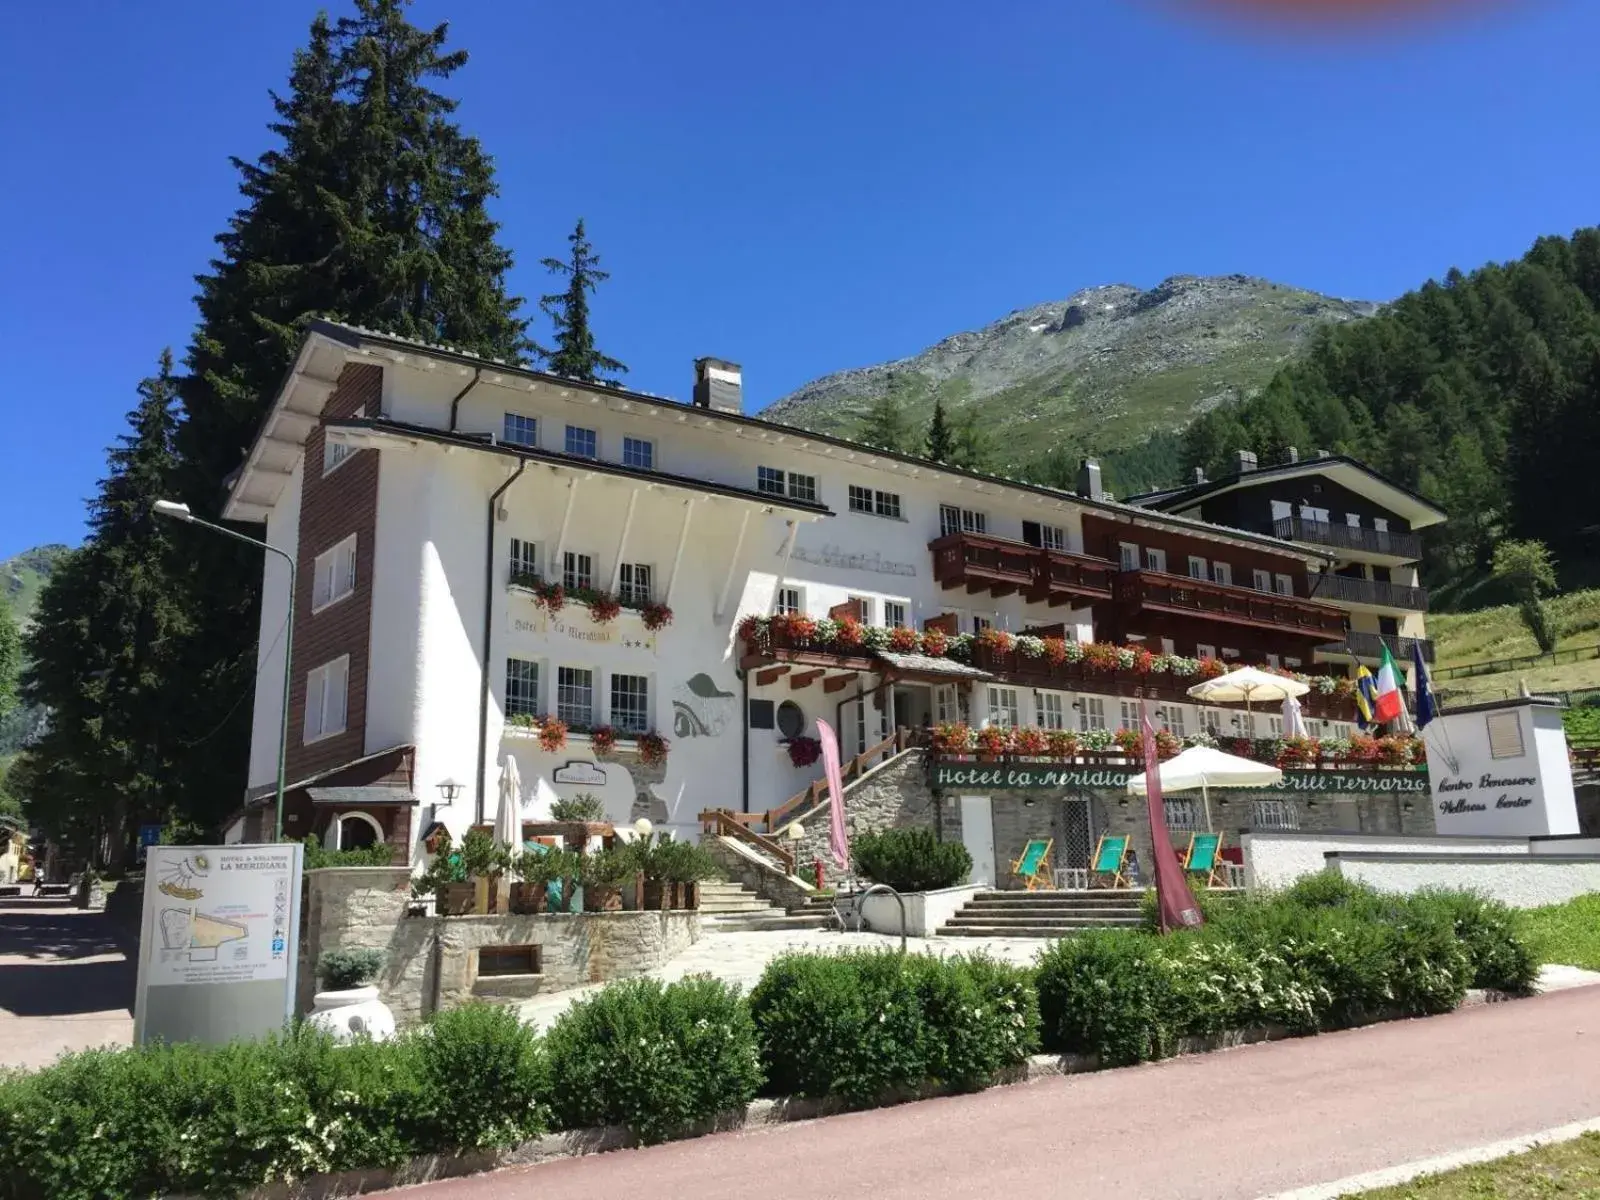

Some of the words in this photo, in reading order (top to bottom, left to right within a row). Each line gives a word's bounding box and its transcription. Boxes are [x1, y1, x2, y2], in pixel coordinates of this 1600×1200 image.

[938, 768, 1002, 785] Hotel
[1039, 769, 1132, 787] Meridia
[1332, 775, 1425, 791] Terrazzo
[1438, 778, 1473, 793] Centro
[1479, 773, 1537, 789] Benessere
[1439, 799, 1487, 815] Wellness
[220, 863, 232, 871] LA
